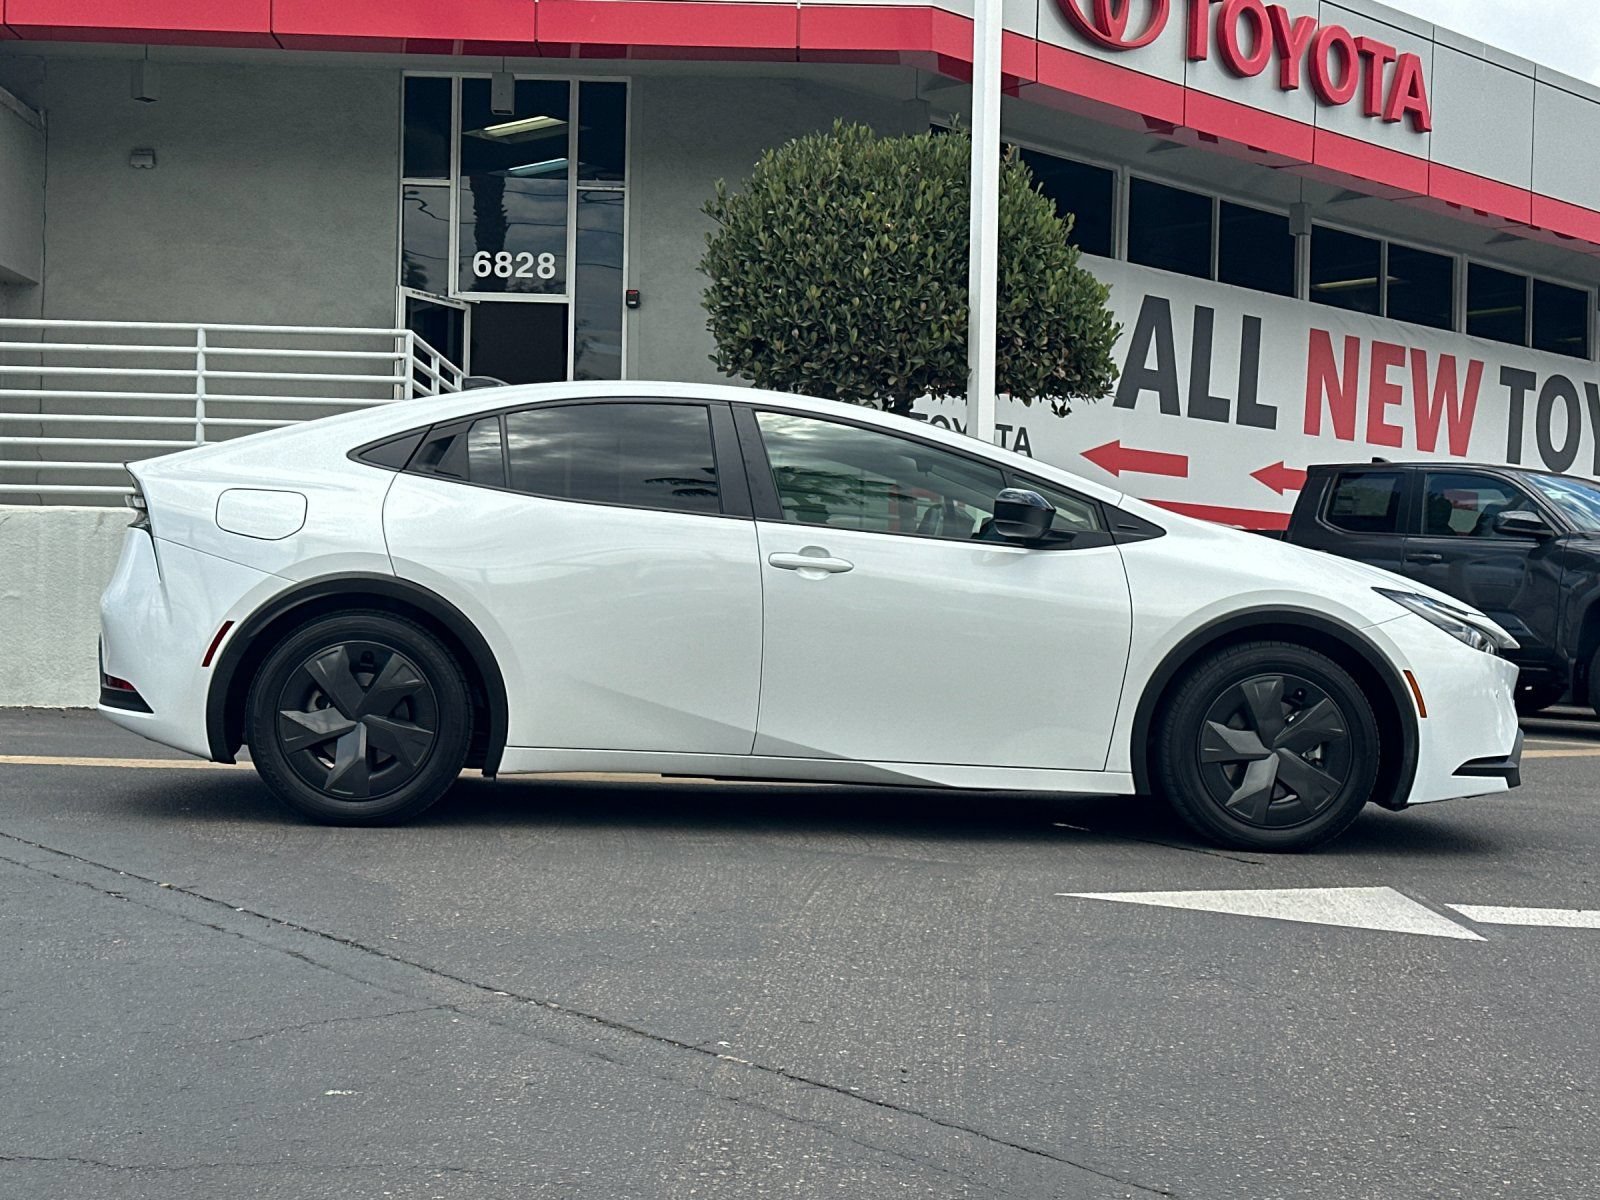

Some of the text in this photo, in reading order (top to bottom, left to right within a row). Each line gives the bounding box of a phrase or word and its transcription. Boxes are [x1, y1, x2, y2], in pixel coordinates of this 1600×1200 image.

[1187, 0, 1433, 133] TOYOTA
[472, 250, 556, 280] 6828
[1113, 294, 1277, 431] ALL
[1303, 328, 1484, 457] NEW
